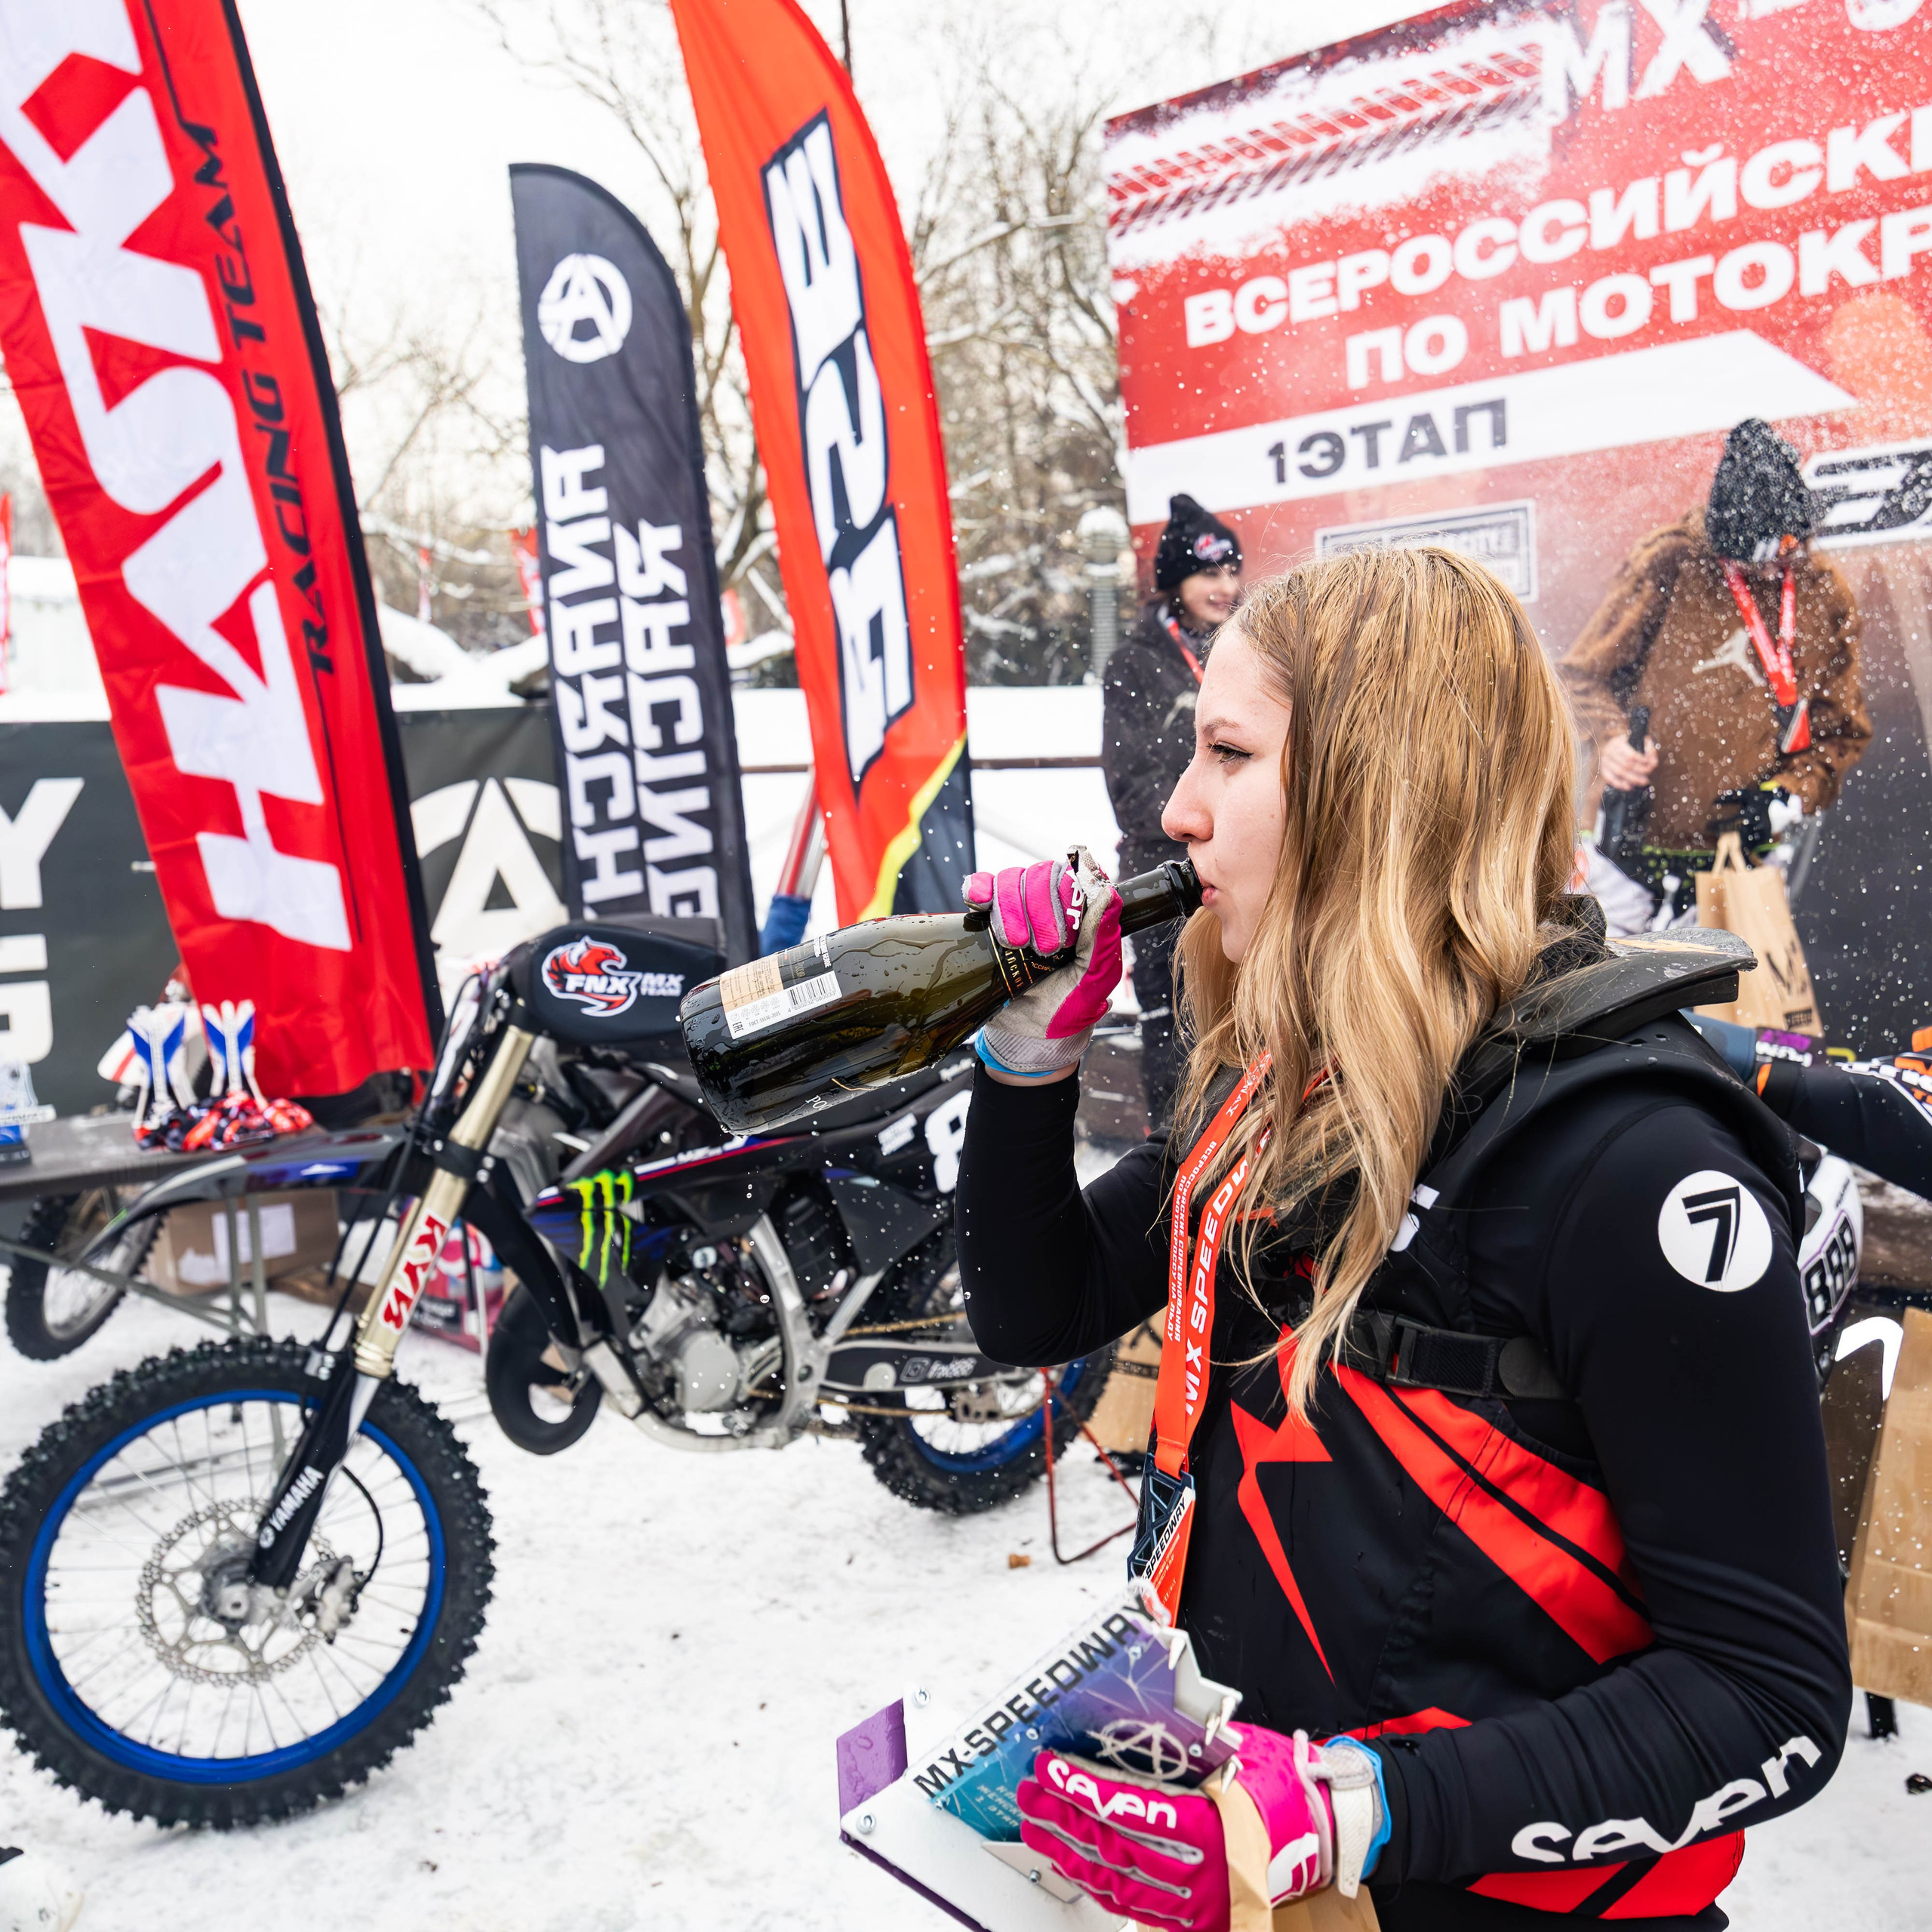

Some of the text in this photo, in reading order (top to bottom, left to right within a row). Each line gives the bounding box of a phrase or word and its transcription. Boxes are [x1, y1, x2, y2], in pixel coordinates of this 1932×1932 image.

[178, 118, 334, 675] RACING TEAM
[1345, 312, 1469, 390] ПО
[565, 974, 631, 994] FNX
[1168, 1174, 1187, 1342] ПО МОТОКРОССУ НА ЛЬДУ
[1174, 1140, 1217, 1343] ВСЕРОССИЙСКИЕ СОРЕВНОВАНИЯ
[1185, 1337, 1202, 1417] MX
[268, 1464, 326, 1532] YAMAHA
[913, 1592, 1157, 1800] MX-SPEEDWAY
